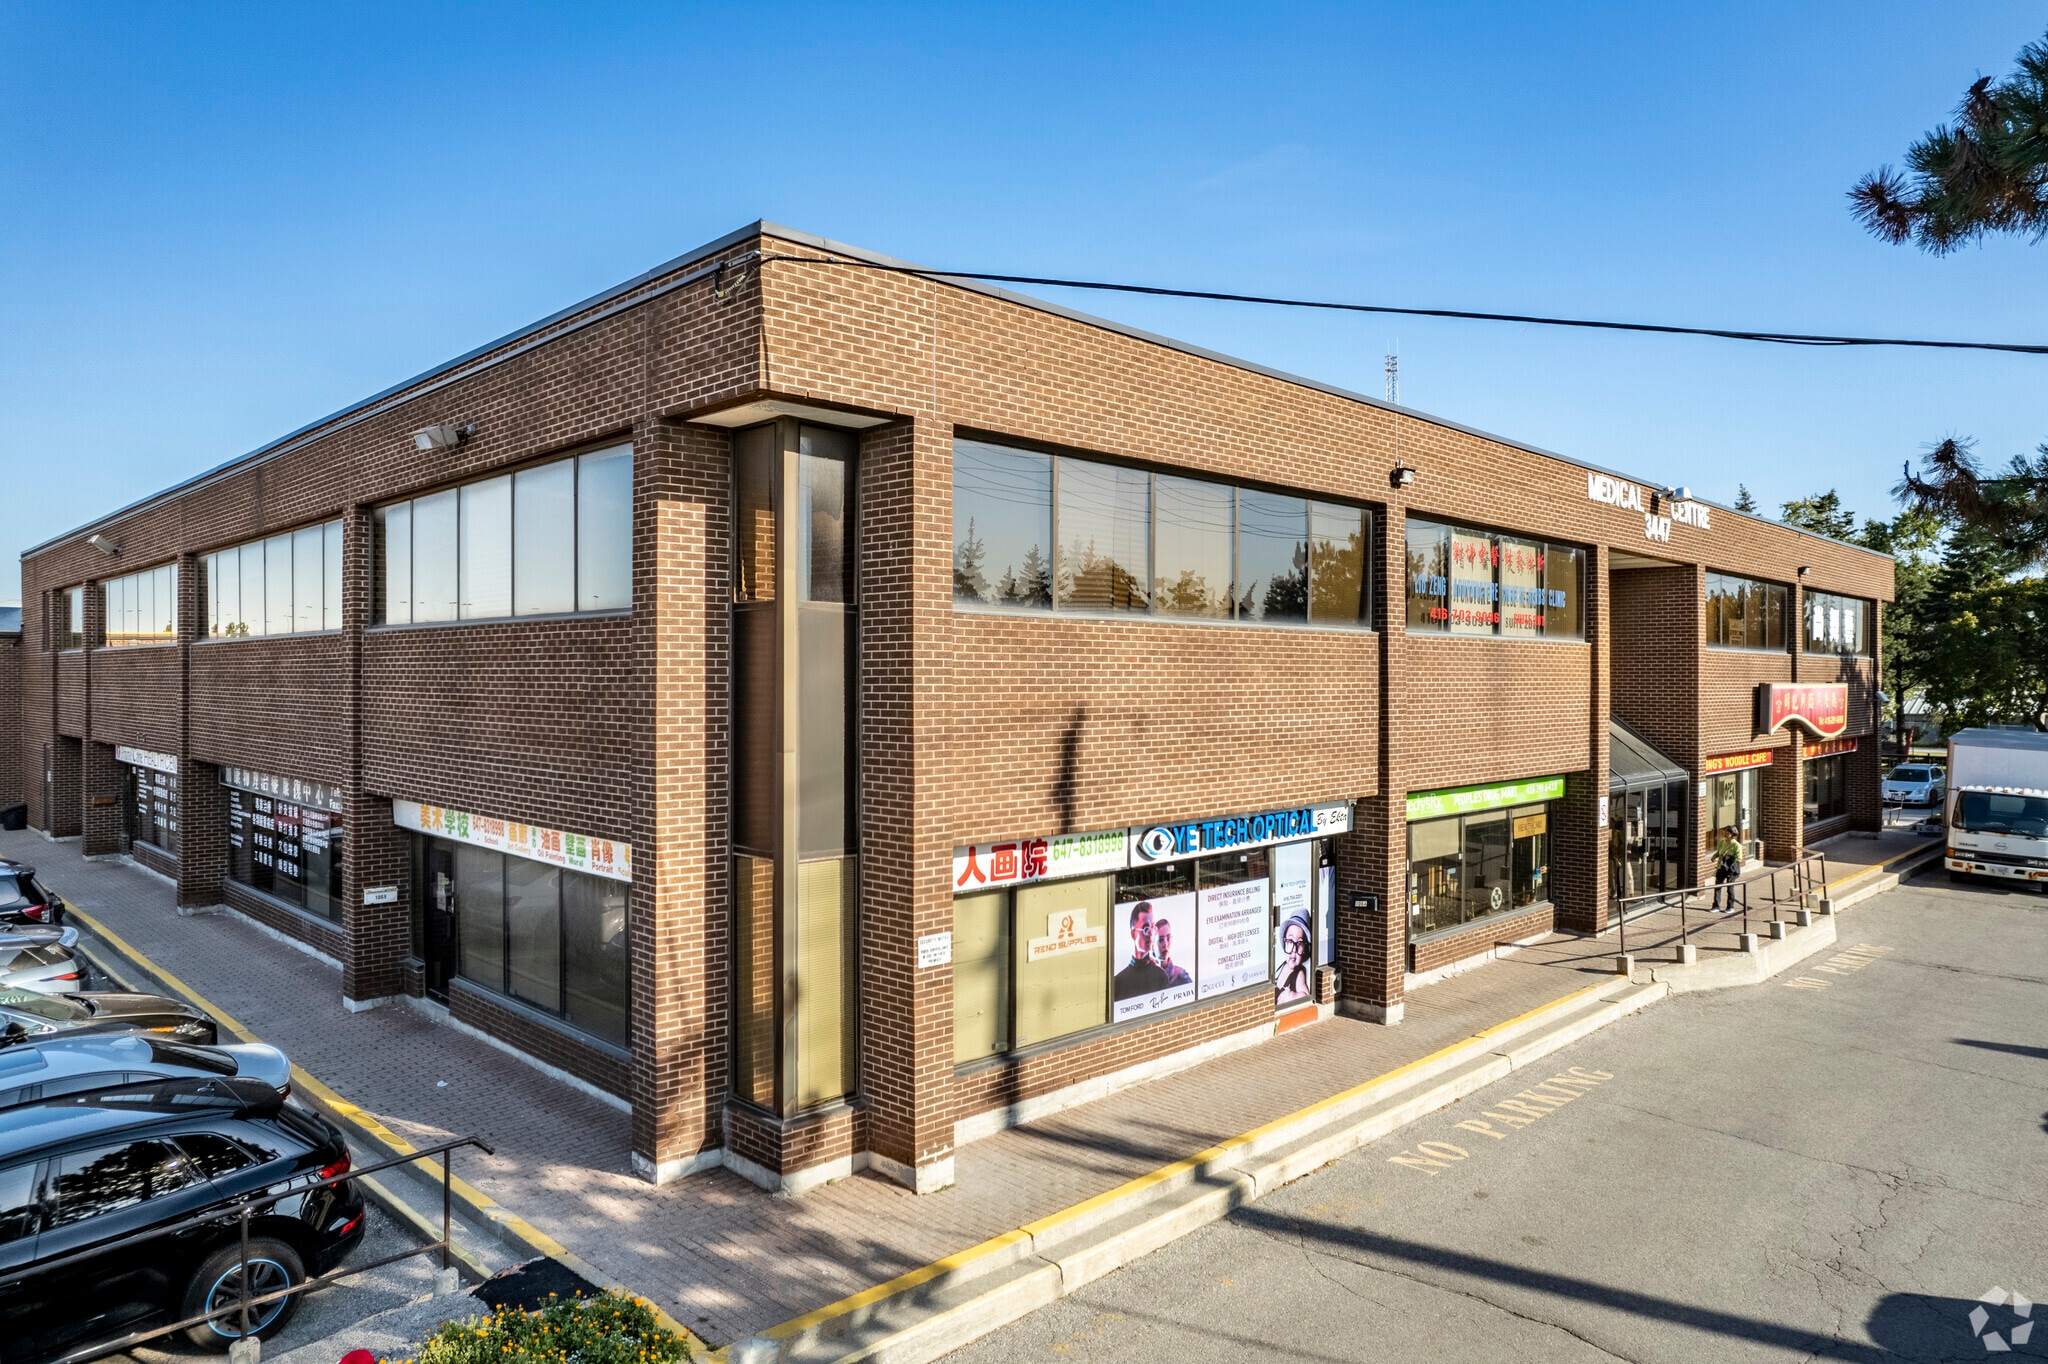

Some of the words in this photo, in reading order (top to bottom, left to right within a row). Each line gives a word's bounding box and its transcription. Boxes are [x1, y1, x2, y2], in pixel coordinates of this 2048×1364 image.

[1587, 472, 1645, 513] MEDICAL
[1670, 501, 1711, 530] CENTRE
[1644, 512, 1671, 543] 3447
[1429, 575, 1447, 597] ZENG
[1549, 589, 1567, 608] CLINIC
[1725, 755, 1750, 769] NOODLE
[1751, 752, 1767, 764] CAFE
[1484, 787, 1500, 801] DRUG
[1501, 785, 1518, 799] MART
[420, 803, 470, 839] 美术学校
[1202, 816, 1250, 850] TECH
[1252, 808, 1319, 843] OPTICAL
[1317, 812, 1328, 826] By
[484, 836, 499, 846] School
[540, 828, 561, 852] 油画
[1052, 831, 1124, 861] 647-8318998
[537, 848, 545, 858] Oil
[545, 850, 566, 865] Painting
[591, 838, 614, 864] 肖像
[568, 856, 584, 867] Mural
[591, 861, 614, 874] Portrait
[956, 838, 1049, 887] 人画院
[1207, 892, 1222, 903] DIRECT
[1222, 888, 1245, 900] INSURANCE
[1246, 885, 1261, 895] BILLING
[1206, 916, 1214, 925] EYE
[1214, 910, 1241, 923] EXAMINATION
[1241, 906, 1262, 917] ARRANGED
[1033, 944, 1057, 954] RENO
[1058, 935, 1098, 949] SUPPLIES
[1208, 936, 1224, 946] DIGITAL
[1227, 932, 1237, 941] HIGH
[1237, 930, 1245, 939] DEF
[1245, 927, 1260, 937] LENSES
[1217, 954, 1236, 965] CONTACT
[1236, 950, 1251, 961] LENSES
[1782, 976, 1834, 992] NO
[1811, 942, 1896, 976] PARKING
[1173, 989, 1195, 1001] PRADA
[1120, 1004, 1132, 1015] TOM
[1131, 1002, 1144, 1012] FORD
[1386, 1138, 1470, 1177] NO
[1454, 1065, 1615, 1140] PARKING
